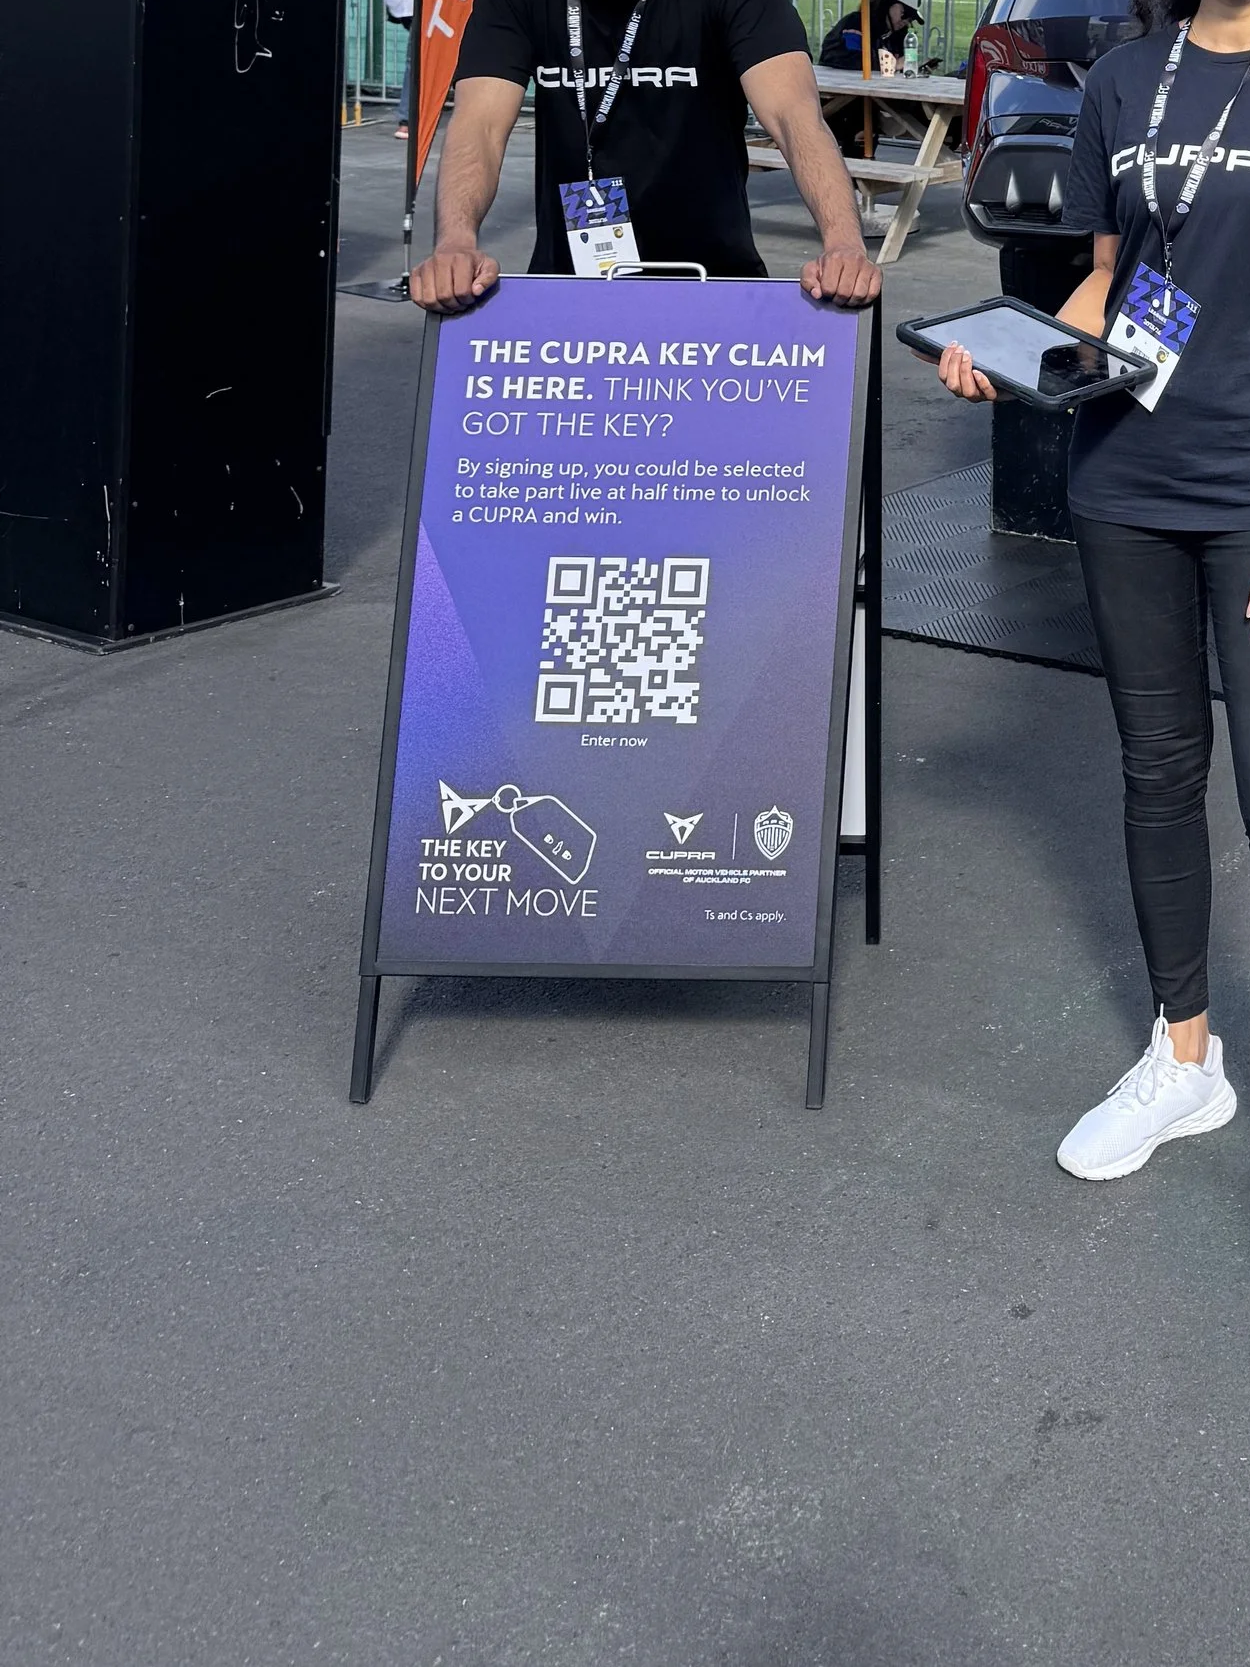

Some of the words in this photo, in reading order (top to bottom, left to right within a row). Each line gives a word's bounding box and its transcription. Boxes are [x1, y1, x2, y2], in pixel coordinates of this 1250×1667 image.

[537, 66, 698, 87] CUPRA
[1180, 163, 1205, 204] AUCKLAND
[470, 341, 531, 363] THE
[541, 341, 650, 364] CUPRA
[660, 343, 721, 365] KEY
[729, 344, 824, 366] CLAIM
[466, 376, 493, 398] IS
[503, 377, 592, 400] HERE.
[604, 378, 692, 401] THINK
[463, 412, 528, 435] GOT
[537, 413, 595, 435] THE
[604, 414, 673, 436] KEY?
[458, 458, 480, 477] By
[486, 458, 553, 478] signing
[559, 464, 588, 478] up,
[594, 464, 629, 479] you
[635, 460, 688, 476] could
[695, 460, 717, 476] be
[724, 461, 804, 477] selected
[455, 484, 474, 498] to
[480, 482, 519, 498] take
[525, 485, 564, 502] part
[570, 483, 601, 499] live
[608, 486, 625, 499] at
[632, 484, 668, 500] half
[673, 484, 715, 500] time
[722, 487, 740, 500] to
[747, 485, 809, 501] unlock
[452, 511, 462, 522] a
[469, 507, 537, 523] CUPRA
[543, 507, 579, 523] and
[585, 508, 621, 523] win.
[581, 735, 616, 746] Enter
[620, 738, 647, 746] now
[421, 839, 461, 856] THE
[467, 840, 507, 857] KEY
[646, 851, 715, 859] CUPRA
[419, 863, 447, 880] TO
[453, 864, 511, 881] YOUR
[416, 887, 498, 914] NEXT
[507, 889, 598, 916] MOVE
[705, 910, 715, 919] Ts
[718, 910, 737, 920] and
[740, 911, 753, 920] Cs
[756, 911, 786, 923] apply.
